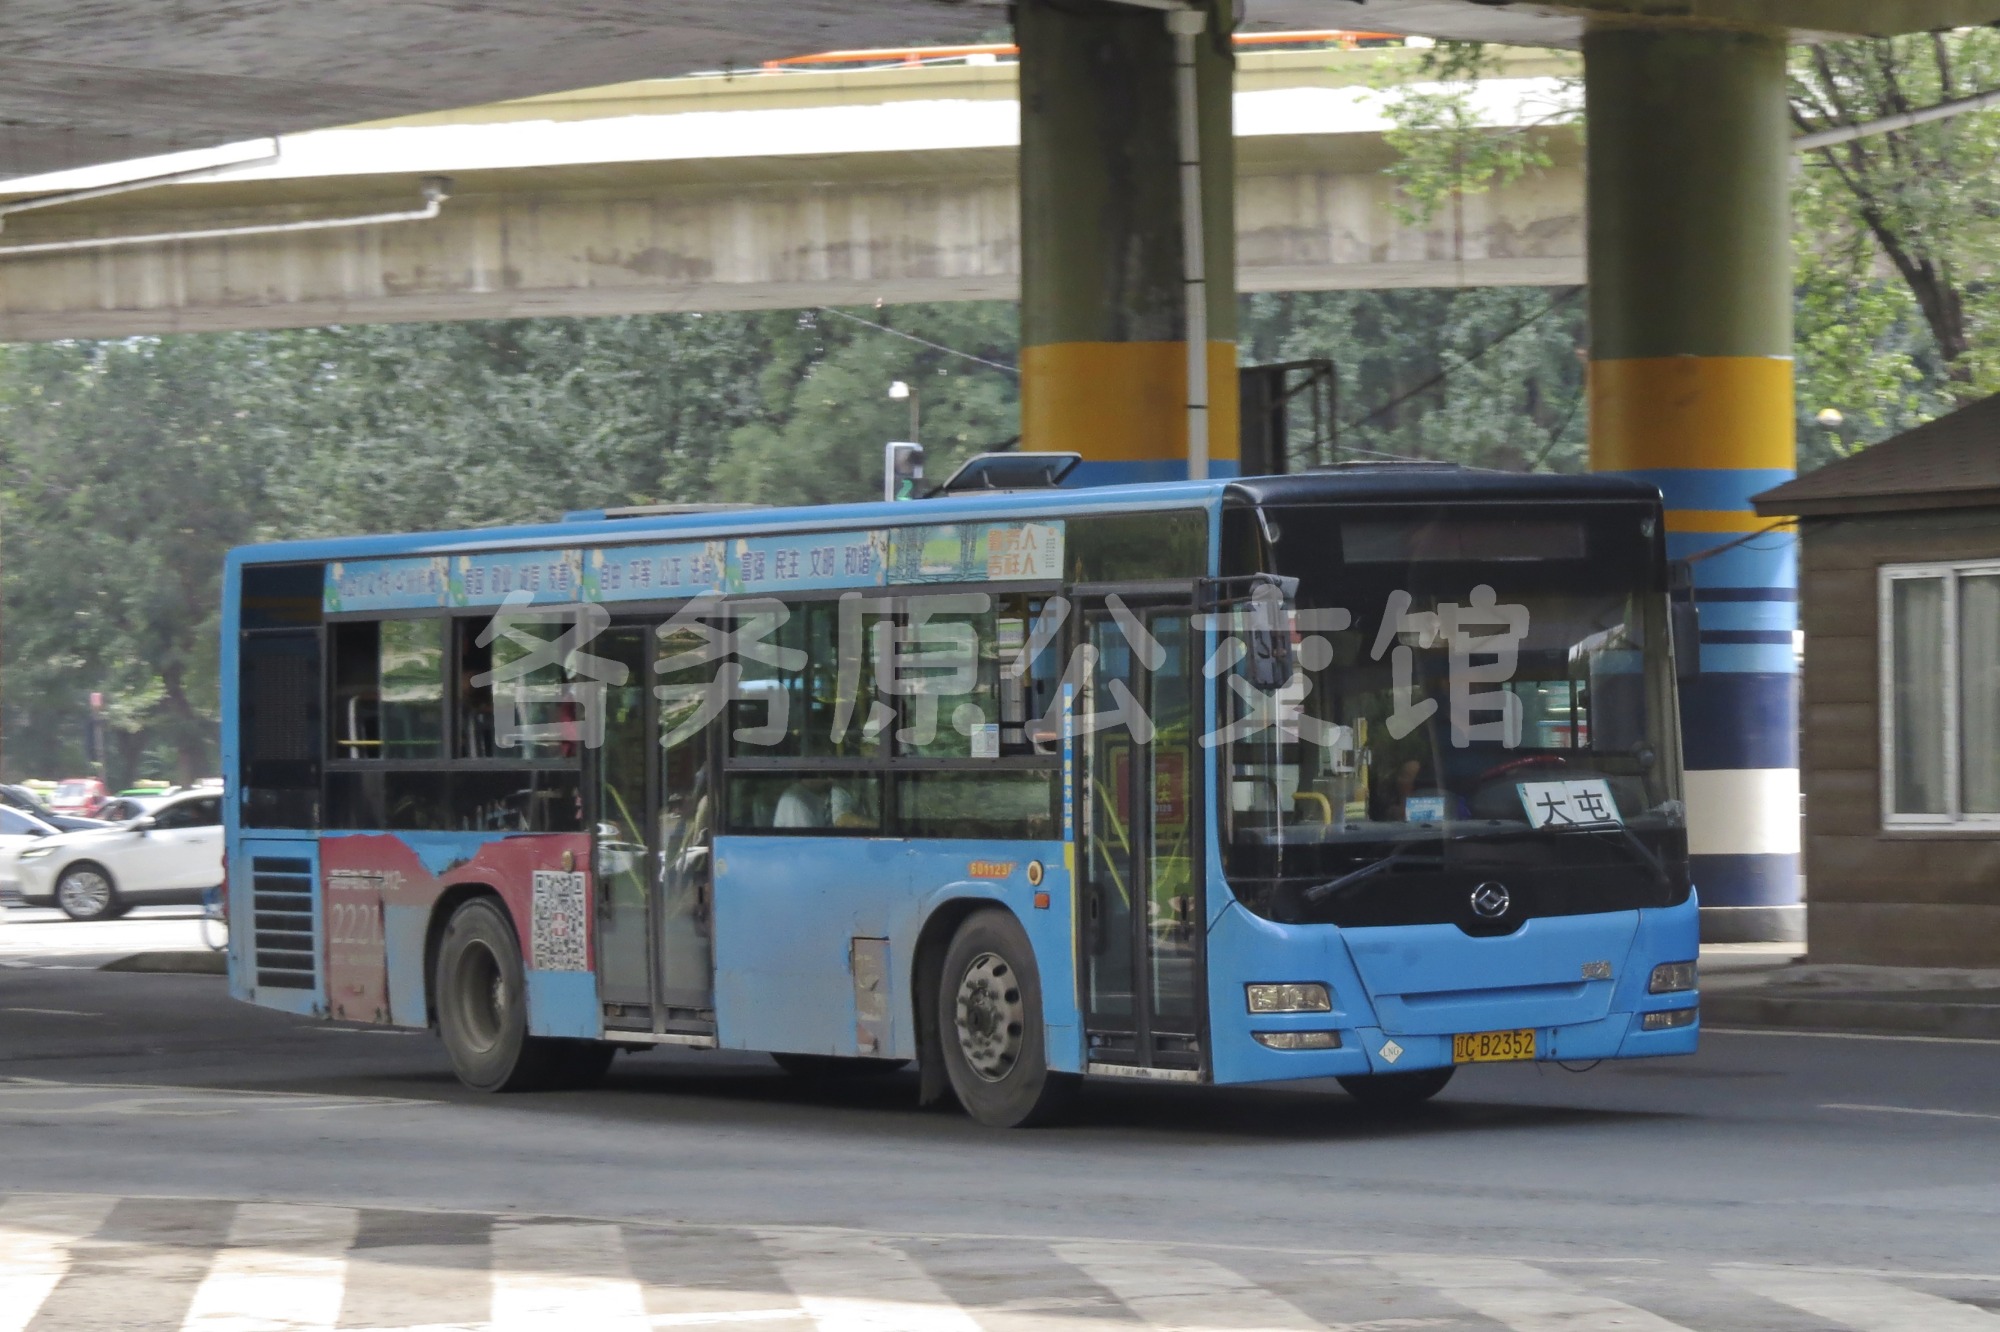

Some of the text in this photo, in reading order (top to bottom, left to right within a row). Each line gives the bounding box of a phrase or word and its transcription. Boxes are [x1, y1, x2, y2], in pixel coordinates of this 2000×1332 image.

[601, 563, 621, 590] 自由
[628, 560, 652, 588] 平等
[741, 544, 871, 582] 富强 民主 文明 和谐
[1536, 789, 1611, 825] 大屯
[1383, 1046, 1400, 1057] LNG
